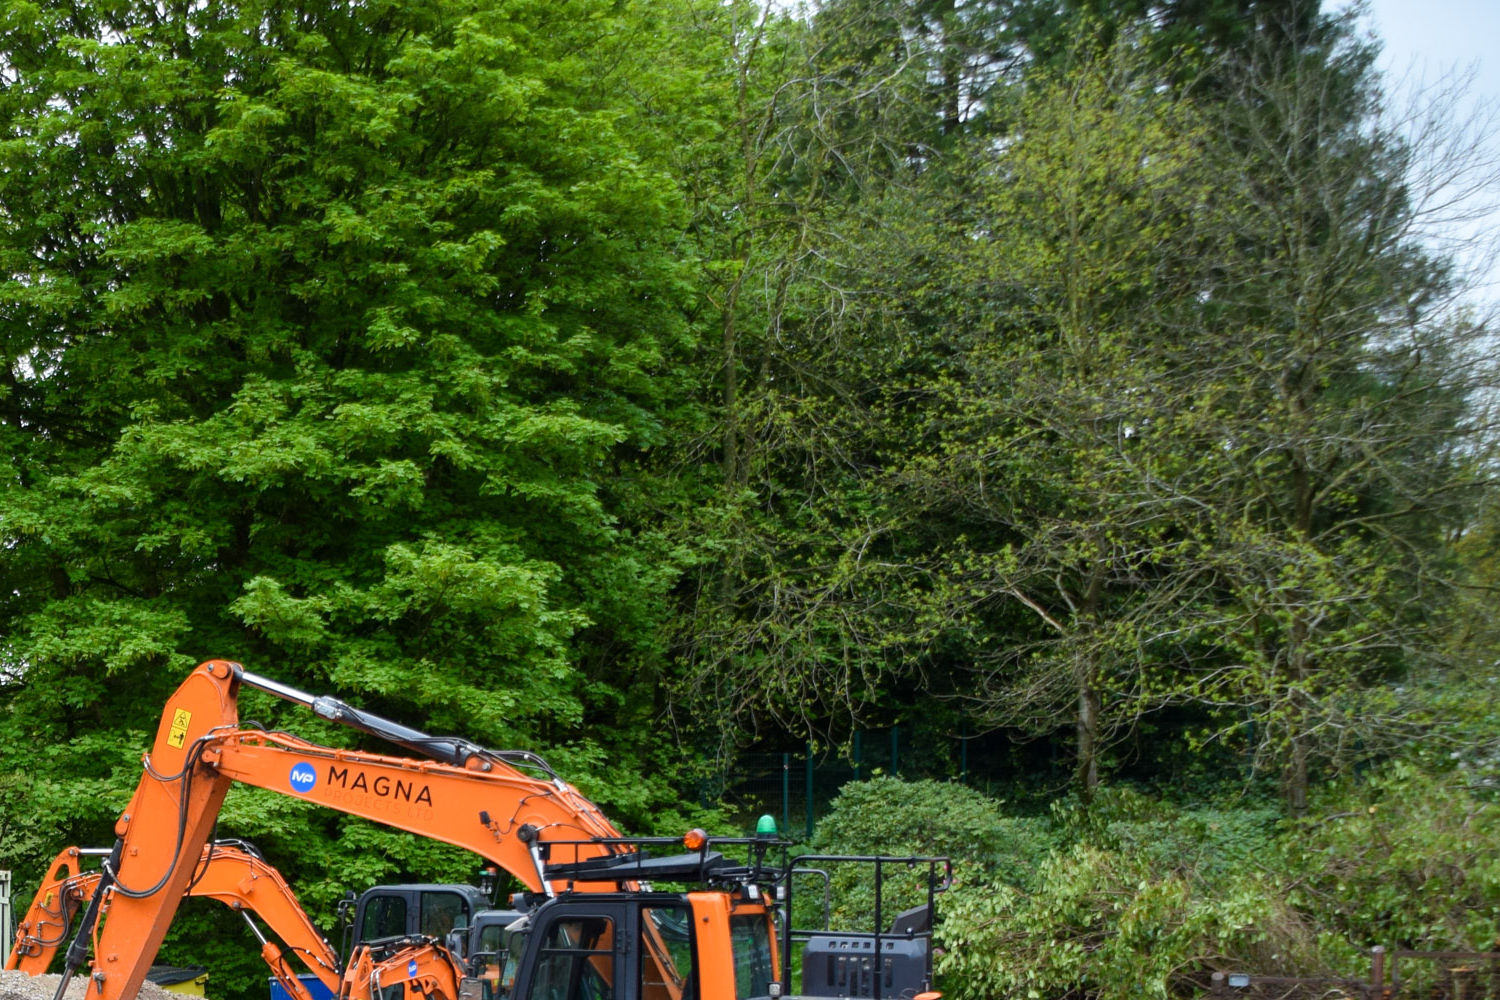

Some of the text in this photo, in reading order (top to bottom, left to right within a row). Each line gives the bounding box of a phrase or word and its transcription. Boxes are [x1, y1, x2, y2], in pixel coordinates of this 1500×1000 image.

[291, 770, 314, 783] MP
[327, 765, 432, 807] MAGNA
[324, 788, 434, 821] PROJECTS LTD
